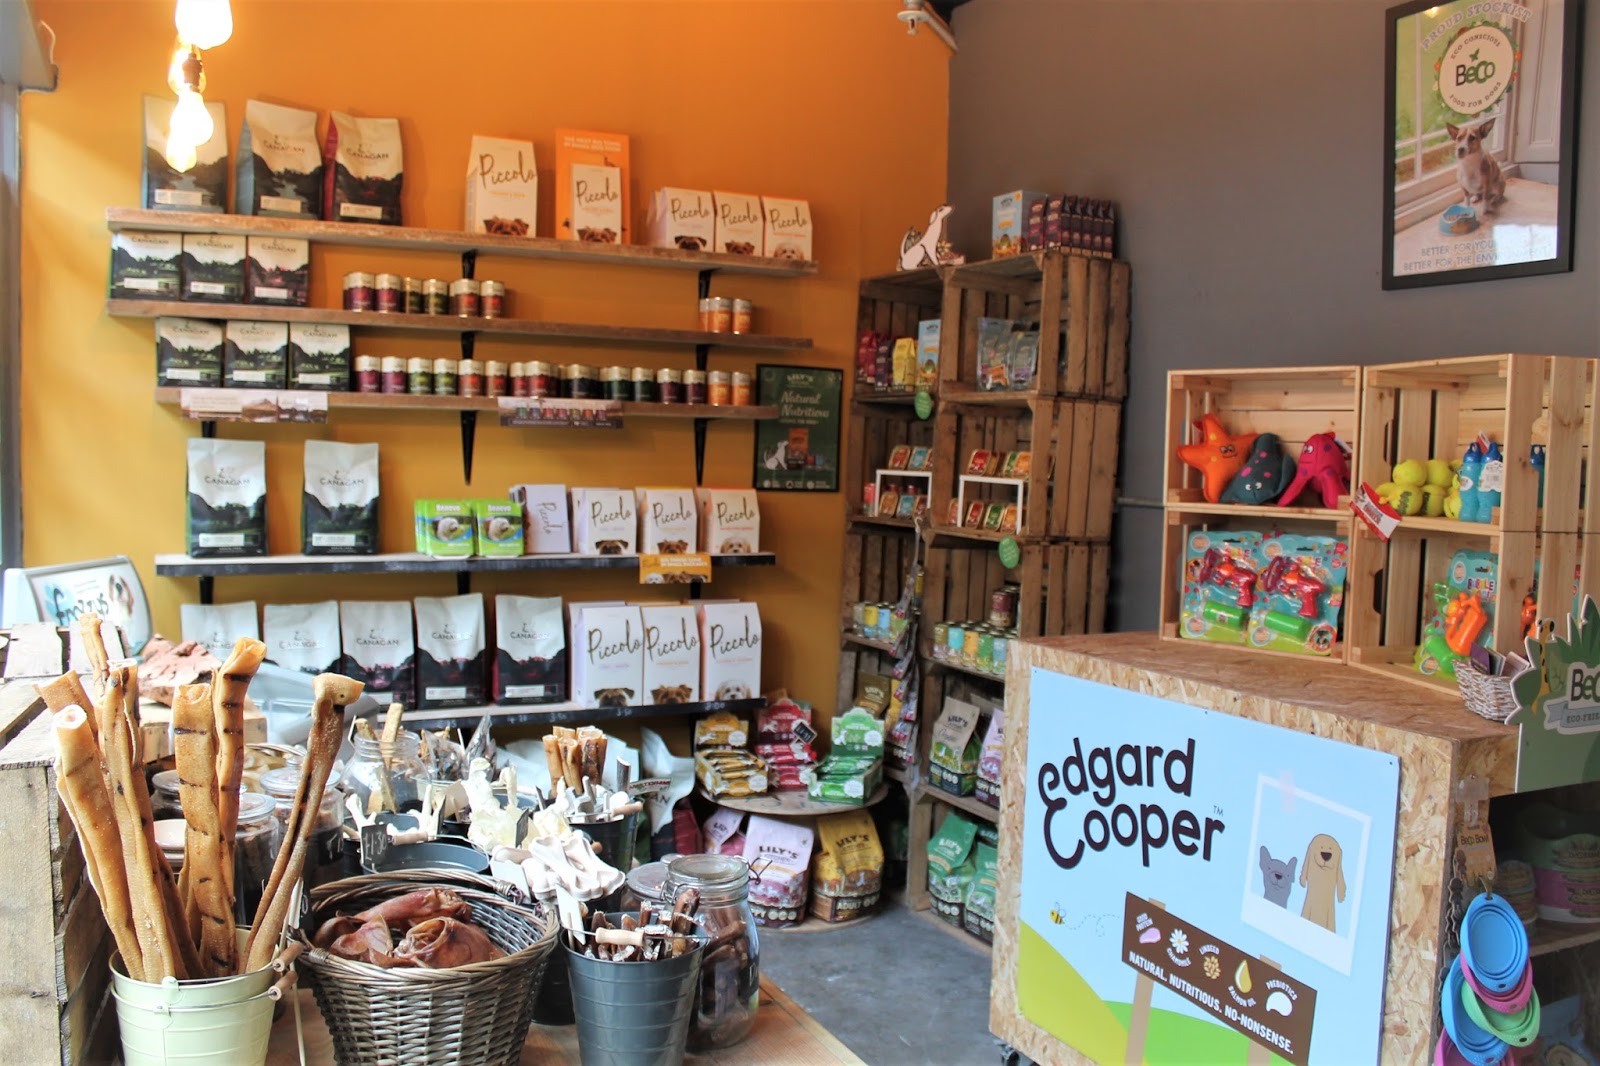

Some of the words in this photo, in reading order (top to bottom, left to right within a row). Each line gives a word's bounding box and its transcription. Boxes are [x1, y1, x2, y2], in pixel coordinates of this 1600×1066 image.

[1422, 13, 1464, 49] PROUD
[1467, 3, 1532, 21] STOCKIST
[1451, 45, 1463, 59] ECO
[1464, 33, 1500, 47] CONSCIOUS
[480, 150, 537, 189] Piccolo
[576, 177, 619, 206] Piccolo
[671, 196, 710, 221] Piccolo
[721, 202, 758, 226] Piccolo
[769, 206, 808, 230] Piccolo
[1421, 245, 1449, 257] BETTER
[1454, 242, 1471, 253] FOR
[1403, 260, 1432, 271] BETTER
[1436, 258, 1452, 268] FOR
[1457, 256, 1472, 265] THE
[204, 476, 250, 485] CANAGAN
[319, 477, 364, 486] CANAGAN
[591, 495, 632, 527] Piccolo
[653, 496, 692, 527] Piccolo
[717, 497, 756, 527] Piccolo
[356, 637, 400, 646] CANAGAN
[588, 619, 642, 664] Piccolo
[646, 617, 699, 661] Piccolo
[710, 615, 760, 658] Piccolo
[1038, 738, 1196, 805] edgard
[835, 834, 870, 848] LILY'S
[1043, 797, 1226, 869] Cooper
[759, 845, 798, 860] LILY'S
[837, 901, 862, 911] ADULT
[1136, 918, 1153, 932] PROTEIN
[1199, 944, 1220, 955] LINSEED
[1227, 985, 1248, 1008] SALMON
[1247, 997, 1257, 1008] OIL
[1265, 979, 1298, 1001] PREBIOTICS
[1129, 951, 1167, 982] NATURAL.
[1169, 973, 1222, 1014] NUTRITIOUS.
[1225, 1005, 1294, 1055] NO-NONSENSE.
